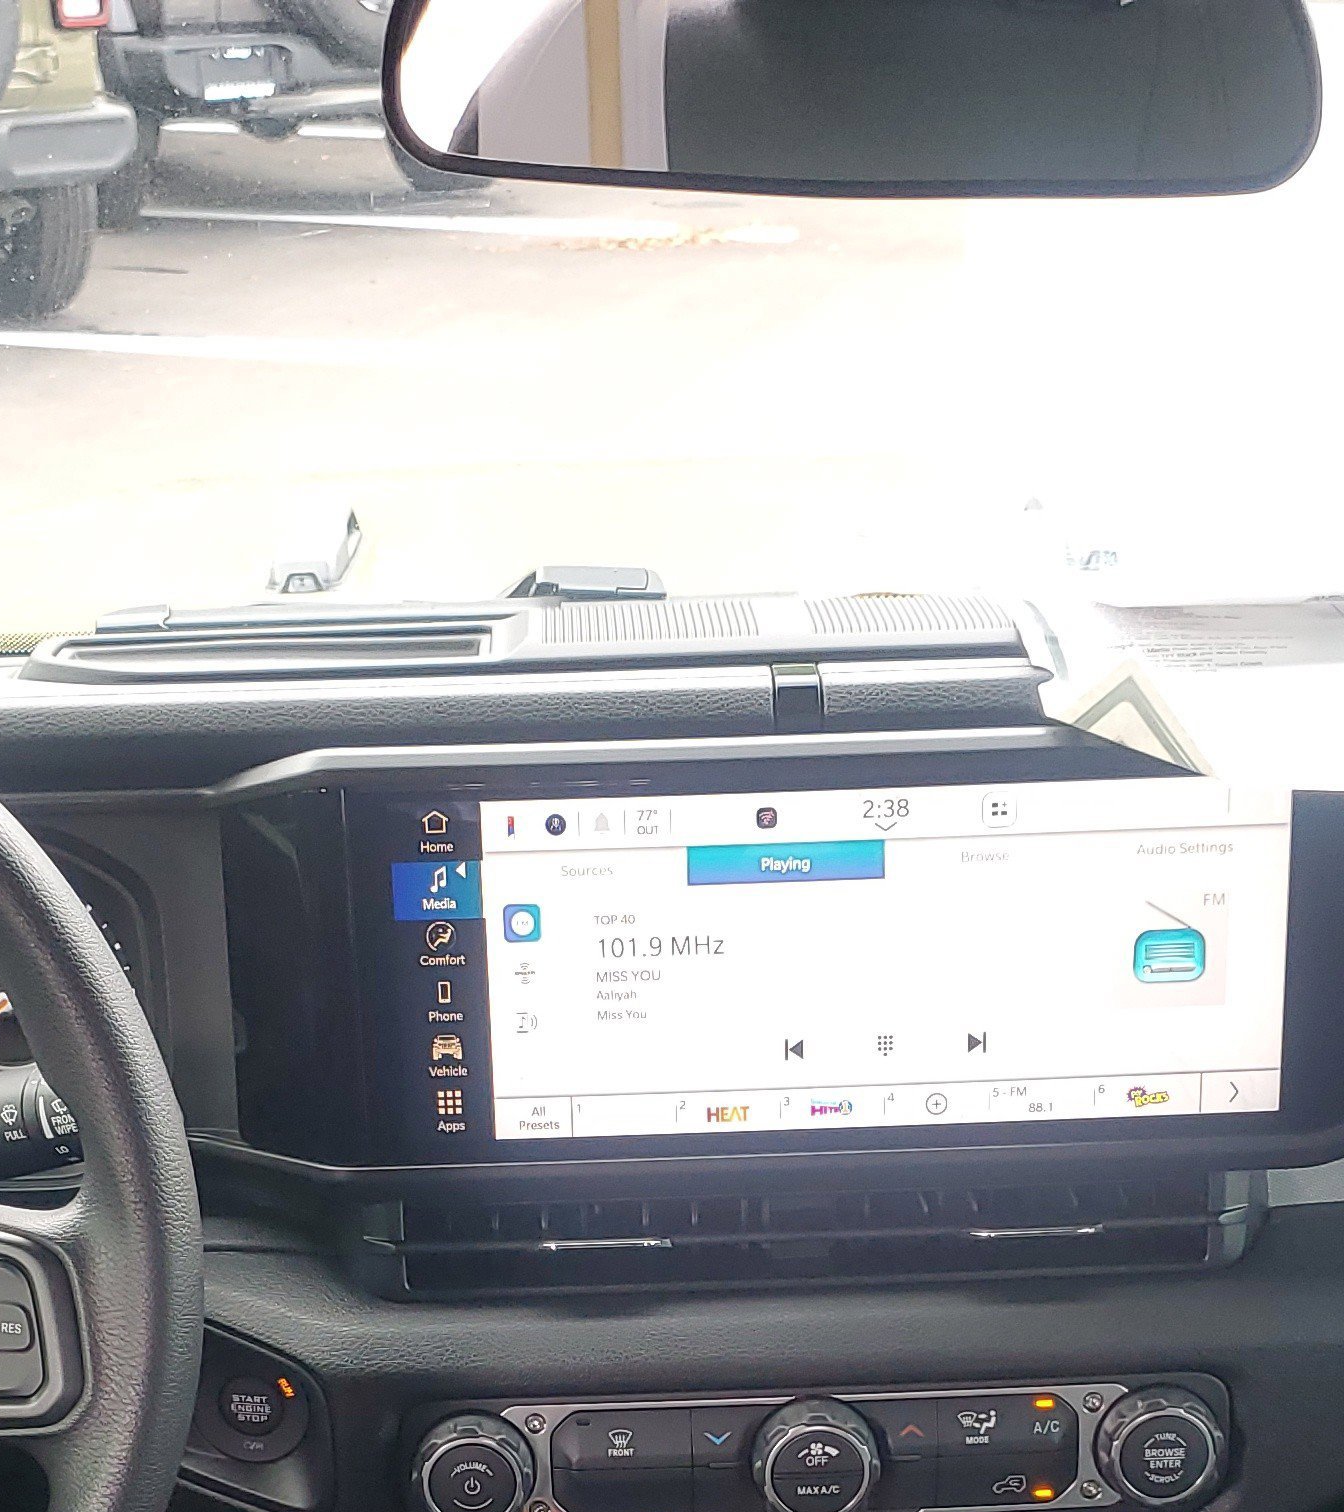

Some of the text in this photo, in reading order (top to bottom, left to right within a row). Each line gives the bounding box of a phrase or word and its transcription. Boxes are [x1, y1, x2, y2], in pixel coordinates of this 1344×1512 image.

[863, 799, 910, 818] 2:38
[637, 809, 658, 822] 77°
[637, 825, 659, 835] OUT
[420, 841, 454, 853] Home
[1137, 842, 1233, 855] Audio Settings
[961, 850, 1009, 863] Browse
[761, 857, 811, 873] Playing
[561, 865, 613, 877] Sources
[423, 898, 456, 910] Media
[1203, 893, 1226, 905] FM
[595, 915, 635, 926] TOP 40
[598, 935, 724, 958] 101.9 MHz
[420, 955, 465, 967] Comfort
[596, 970, 662, 983] MISS YOU
[597, 990, 637, 1002] Aaliyah
[428, 1011, 463, 1022] Phone
[597, 1009, 647, 1021] Miss You
[429, 1066, 468, 1077] Vehicle
[1011, 1086, 1027, 1097] FM
[1098, 1085, 1105, 1094] 6
[679, 1101, 686, 1110] 2
[784, 1097, 790, 1106] 3
[532, 1107, 546, 1117] All
[1029, 1103, 1053, 1113] 88.1
[707, 1106, 749, 1123] HEAT
[51, 1114, 75, 1127] FRON
[519, 1120, 560, 1131] Presets
[437, 1121, 465, 1133] Apps
[4, 1129, 27, 1141] PULL
[1, 1323, 22, 1334] RES
[232, 1395, 268, 1403] START
[231, 1404, 272, 1413] ENGINE
[238, 1414, 268, 1422] STOP
[1033, 1421, 1060, 1435] A/C
[966, 1436, 989, 1445] MODE
[608, 1449, 635, 1457] FRONT
[1144, 1448, 1186, 1457] BROWSE
[806, 1456, 828, 1467] OFF
[1149, 1460, 1181, 1469] ENTER
[454, 1461, 487, 1474] VOLUME
[1149, 1473, 1180, 1483] SCROLL
[797, 1485, 840, 1495] MAX A/C
